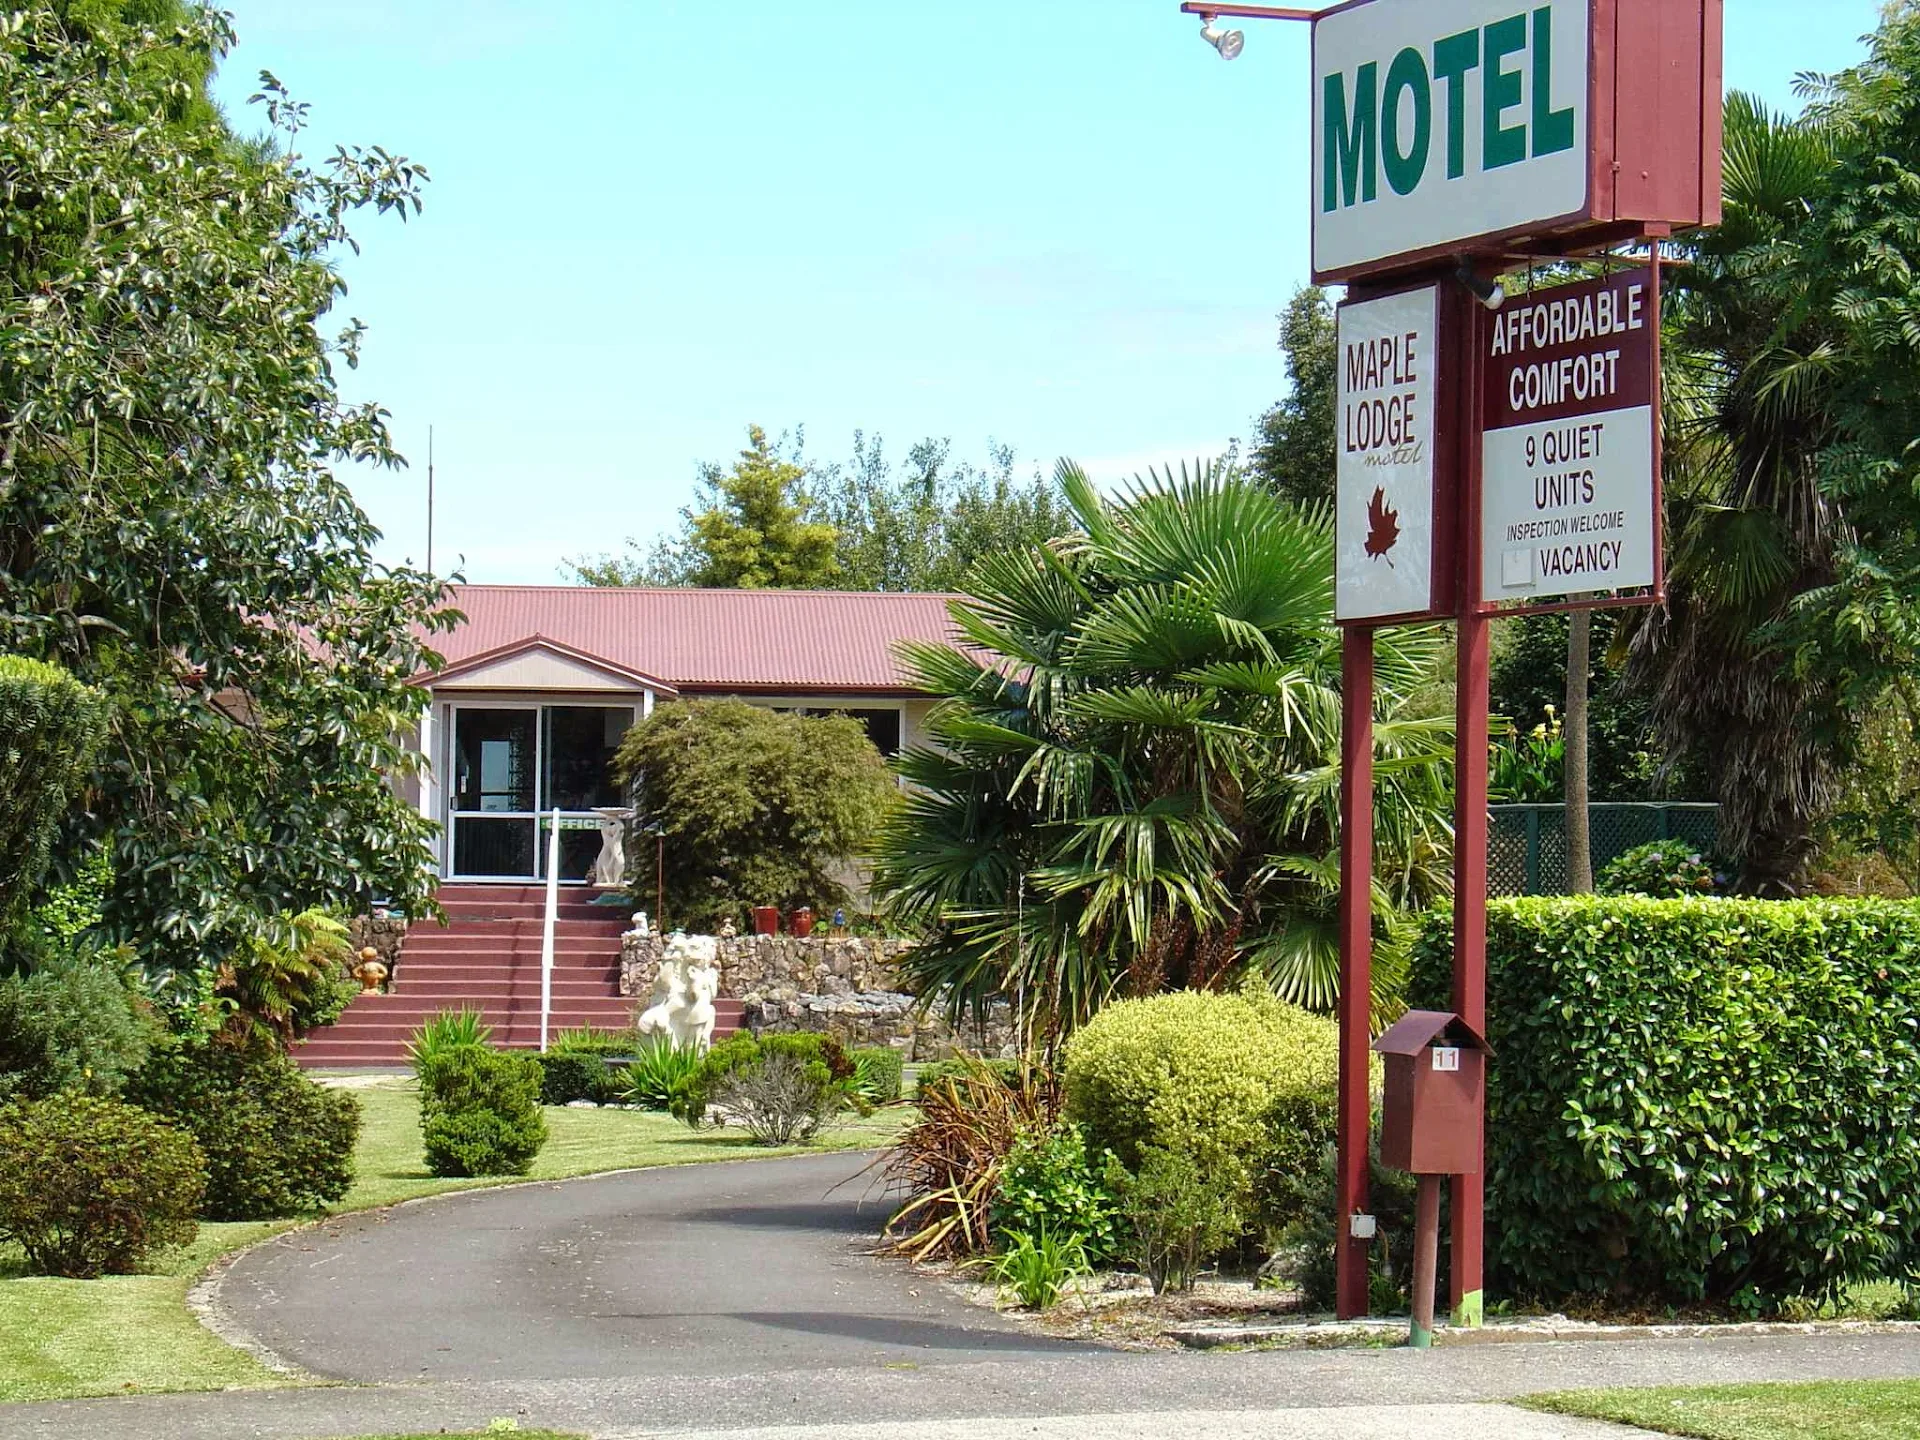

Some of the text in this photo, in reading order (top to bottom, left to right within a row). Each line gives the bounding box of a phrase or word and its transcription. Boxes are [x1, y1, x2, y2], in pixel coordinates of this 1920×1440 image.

[1323, 5, 1575, 213] MOTEL
[1491, 284, 1643, 357] AFFORDABLE
[1347, 332, 1418, 393] MAPLE
[1509, 349, 1620, 412] COMFORT
[1346, 393, 1416, 452] LODGE
[1364, 441, 1422, 467] motel
[1526, 423, 1604, 468] 9 QUIET
[1535, 469, 1594, 510] UNITS
[1507, 511, 1624, 542] INSPECTION WELCOME
[1540, 540, 1622, 577] VACANCY
[1436, 1050, 1456, 1067] 11
